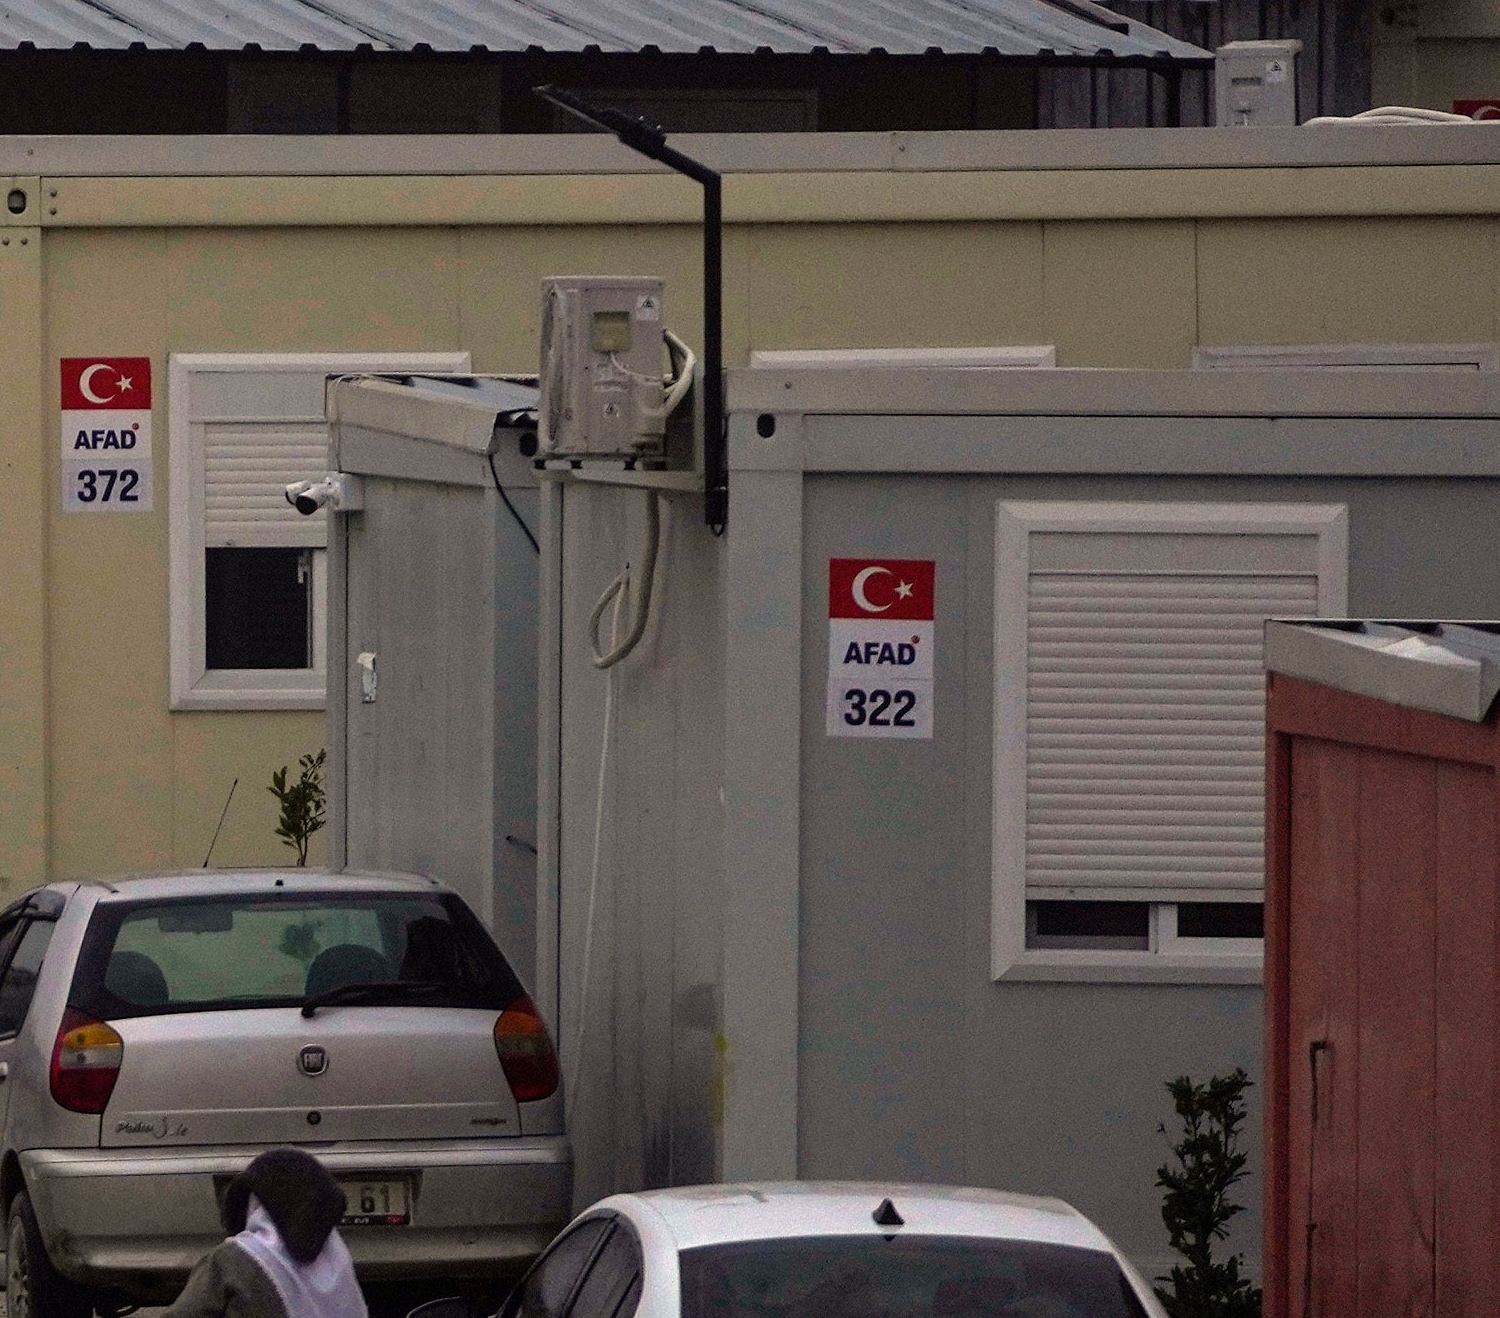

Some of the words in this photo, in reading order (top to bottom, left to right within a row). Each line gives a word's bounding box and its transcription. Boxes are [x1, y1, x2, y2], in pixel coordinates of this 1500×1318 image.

[73, 429, 137, 450] AFAD
[76, 469, 140, 503] 372
[843, 642, 917, 666] AFAD
[843, 688, 917, 727] 322
